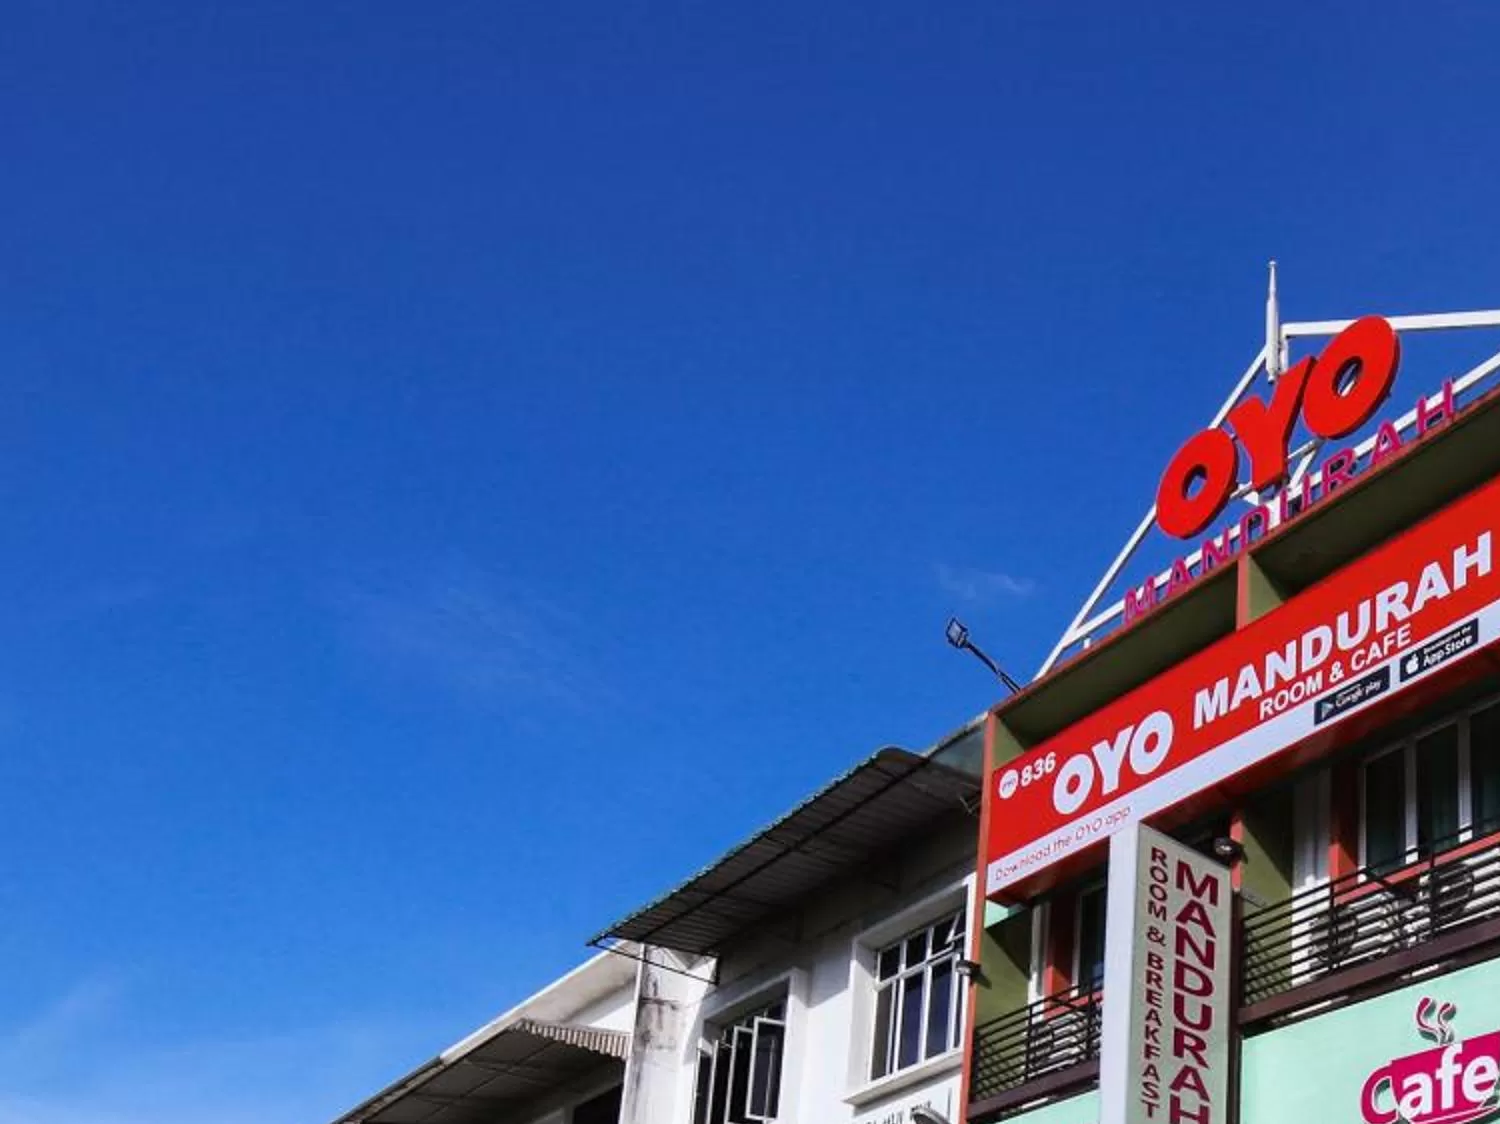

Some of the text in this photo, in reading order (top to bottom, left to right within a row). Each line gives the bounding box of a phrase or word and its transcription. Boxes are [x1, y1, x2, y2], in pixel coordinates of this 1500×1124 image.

[1155, 315, 1401, 540] OYO
[1020, 529, 1492, 815] 836 OYO MANDURAH
[1258, 622, 1412, 720] ROOM & CAFE
[1423, 635, 1473, 667] App Store
[995, 805, 1132, 881] Download the OYO app
[1142, 847, 1169, 1119] ROOM & BREAKFAST
